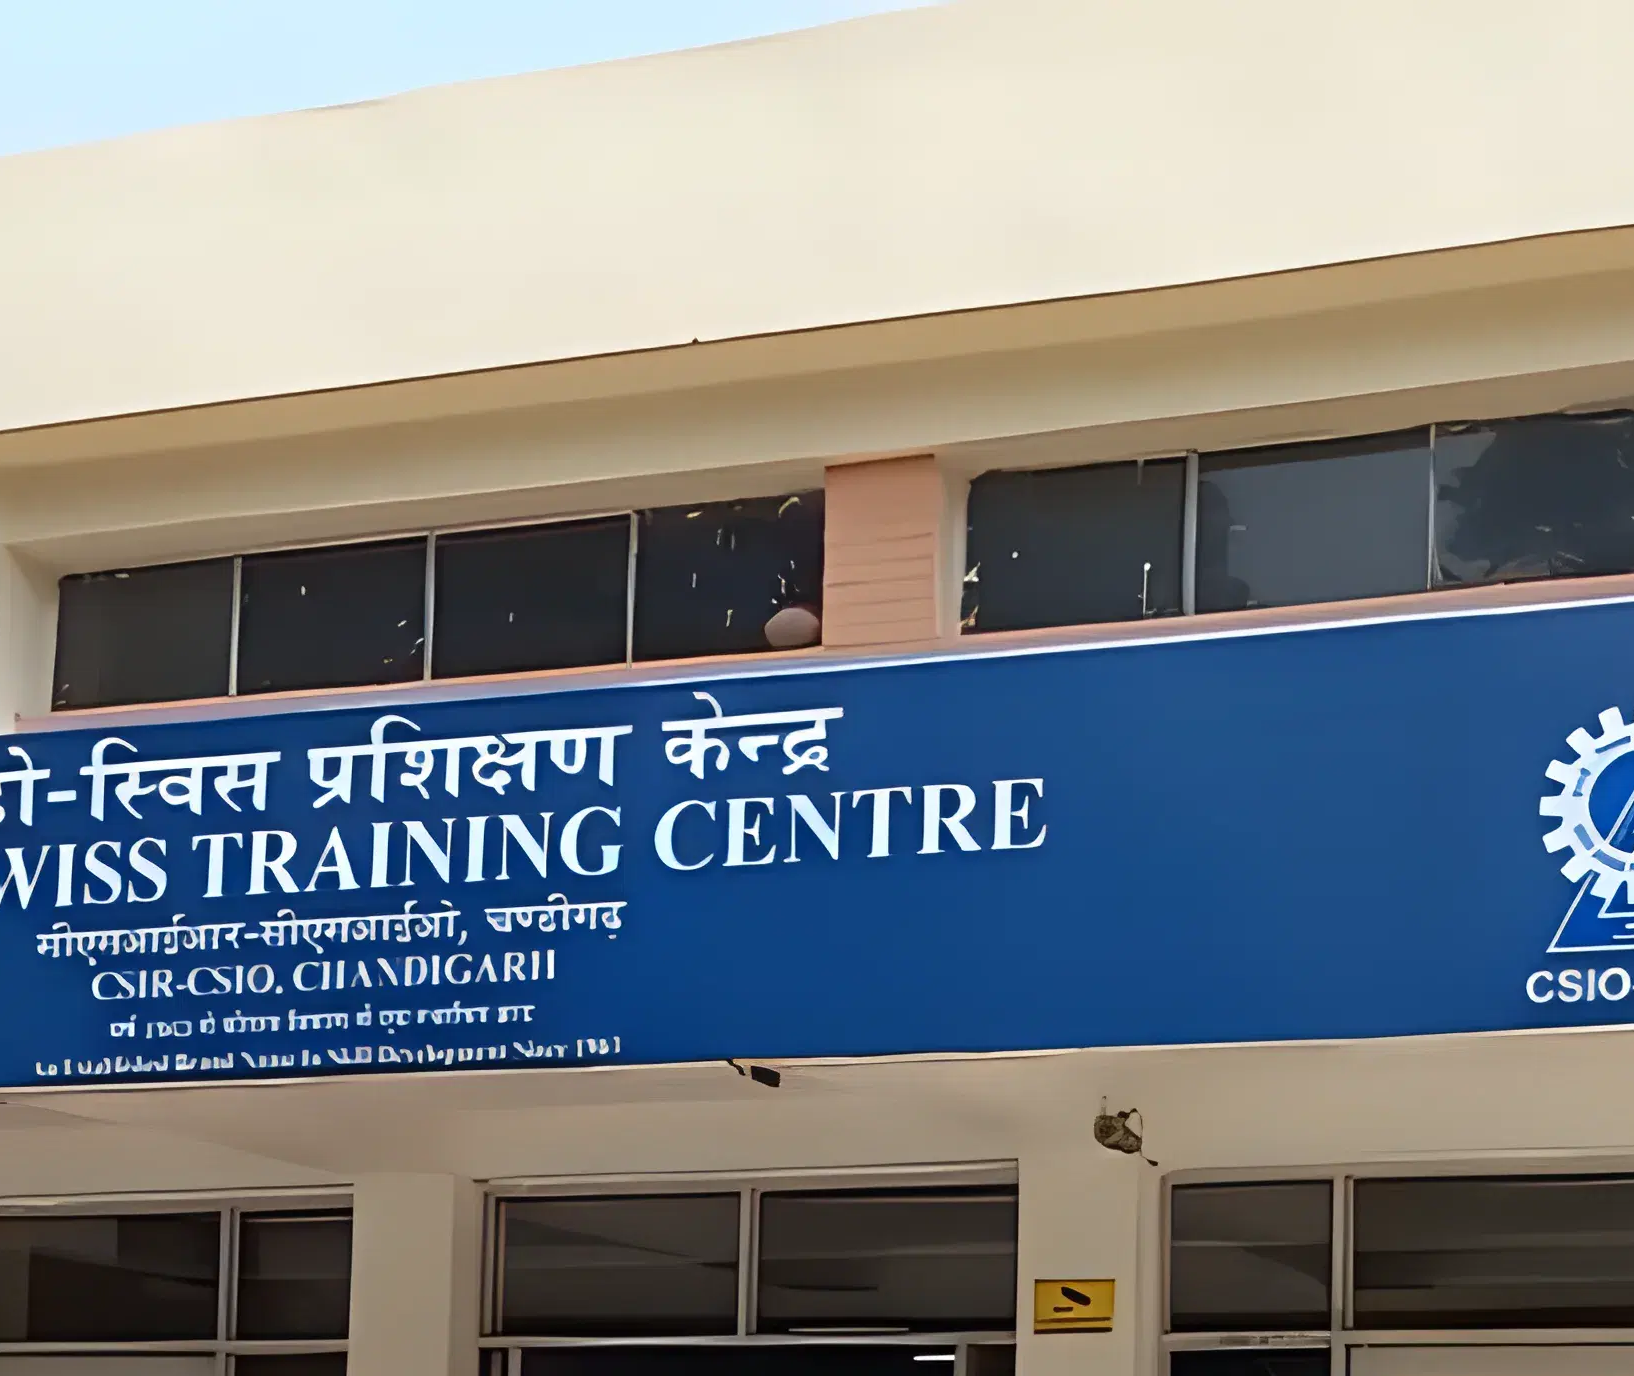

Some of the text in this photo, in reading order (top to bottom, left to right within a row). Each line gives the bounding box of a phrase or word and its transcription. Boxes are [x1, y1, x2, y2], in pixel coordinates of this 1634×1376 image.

[307, 714, 633, 809] प्रशिक्षण
[661, 691, 844, 779] केन्द्र
[192, 806, 621, 898] TRAINING
[654, 778, 1047, 871] CENTRE
[292, 949, 555, 992] CHANDIGARH
